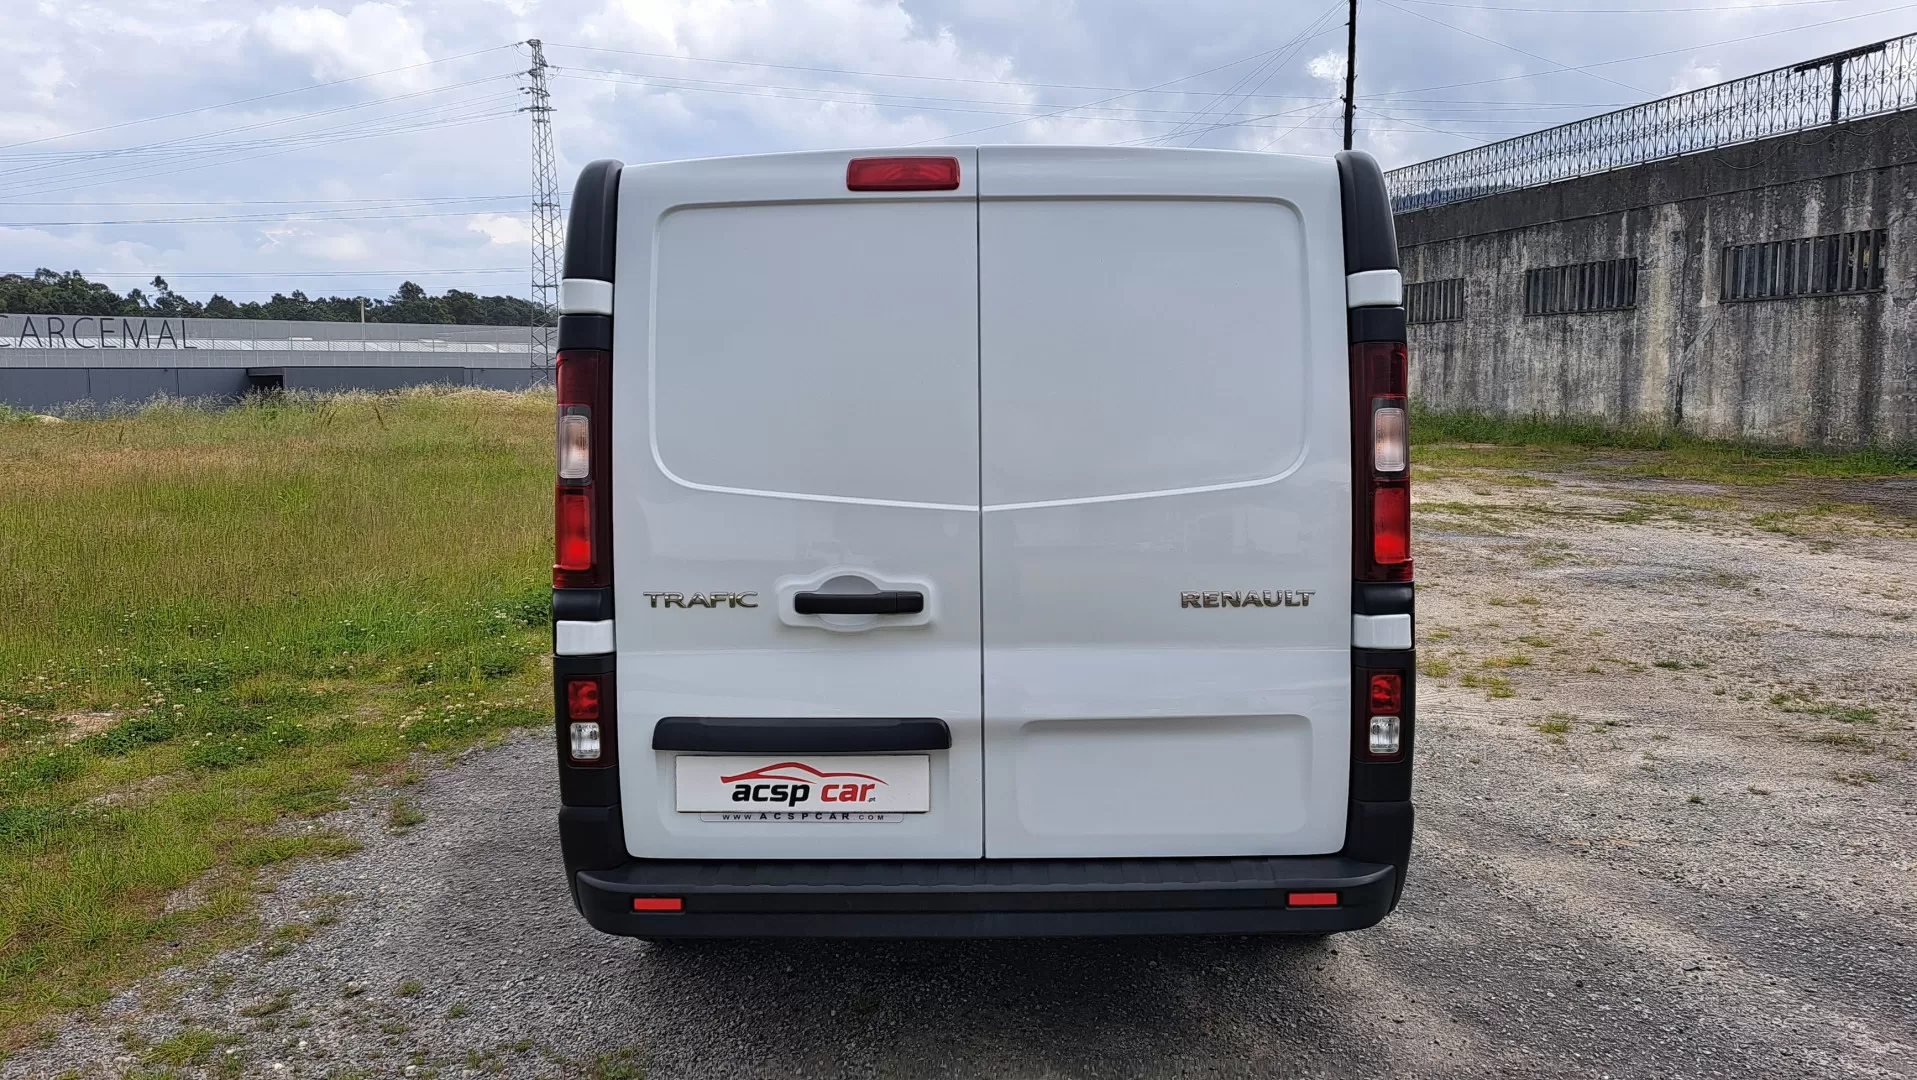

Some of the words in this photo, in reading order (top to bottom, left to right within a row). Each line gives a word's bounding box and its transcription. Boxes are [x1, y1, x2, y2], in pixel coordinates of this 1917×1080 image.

[643, 591, 759, 608] TRAFIC
[1180, 590, 1316, 608] RENAULT
[731, 783, 811, 807] acsp
